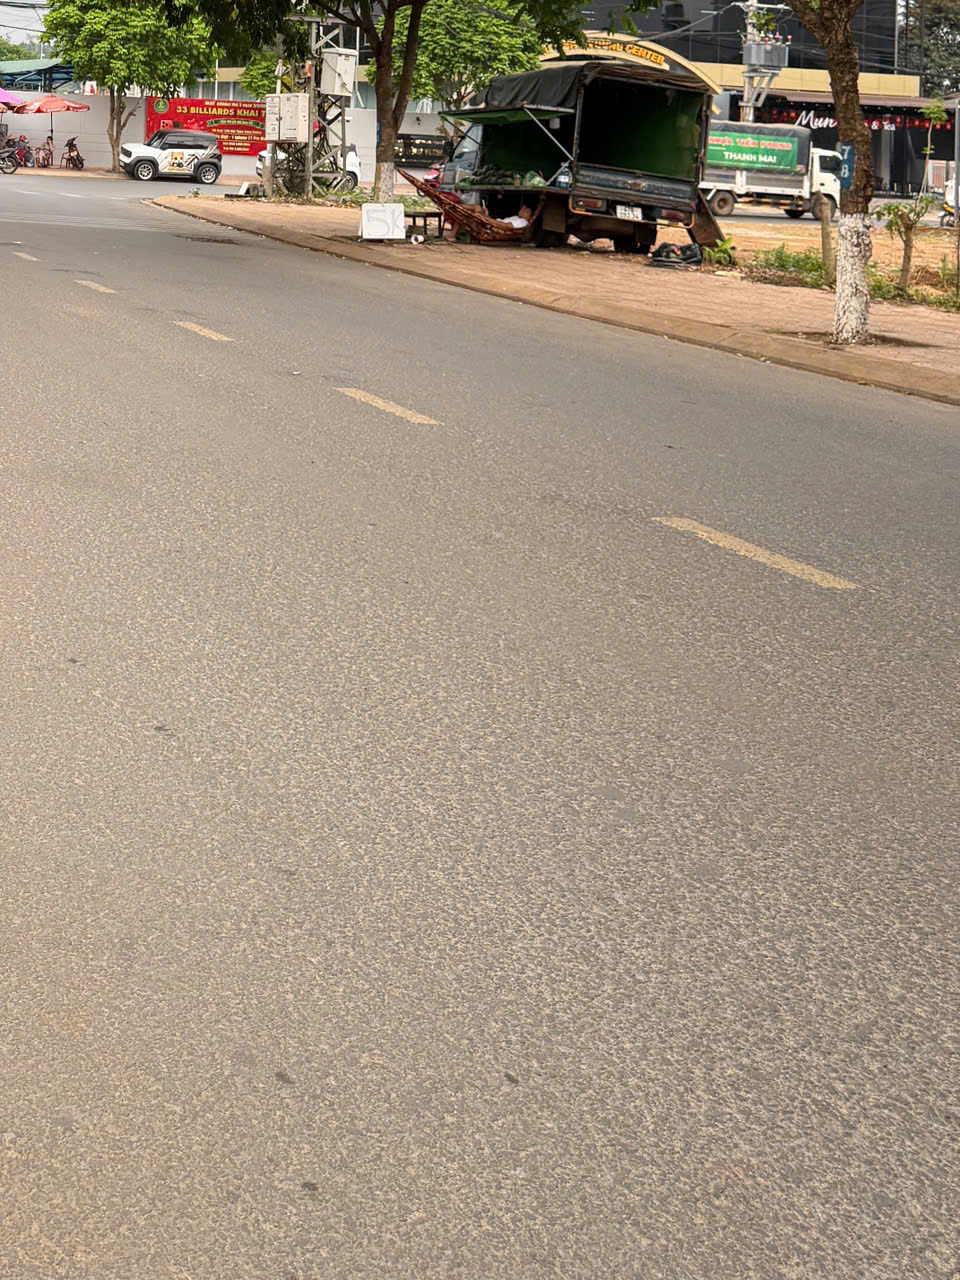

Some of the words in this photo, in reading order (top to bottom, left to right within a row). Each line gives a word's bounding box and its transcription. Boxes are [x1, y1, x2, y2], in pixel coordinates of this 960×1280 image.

[625, 44, 665, 65] CENTER
[190, 106, 235, 116] BILLIARDS
[237, 108, 259, 117] KHAI
[723, 151, 756, 162] THANH
[758, 154, 777, 163] MAI
